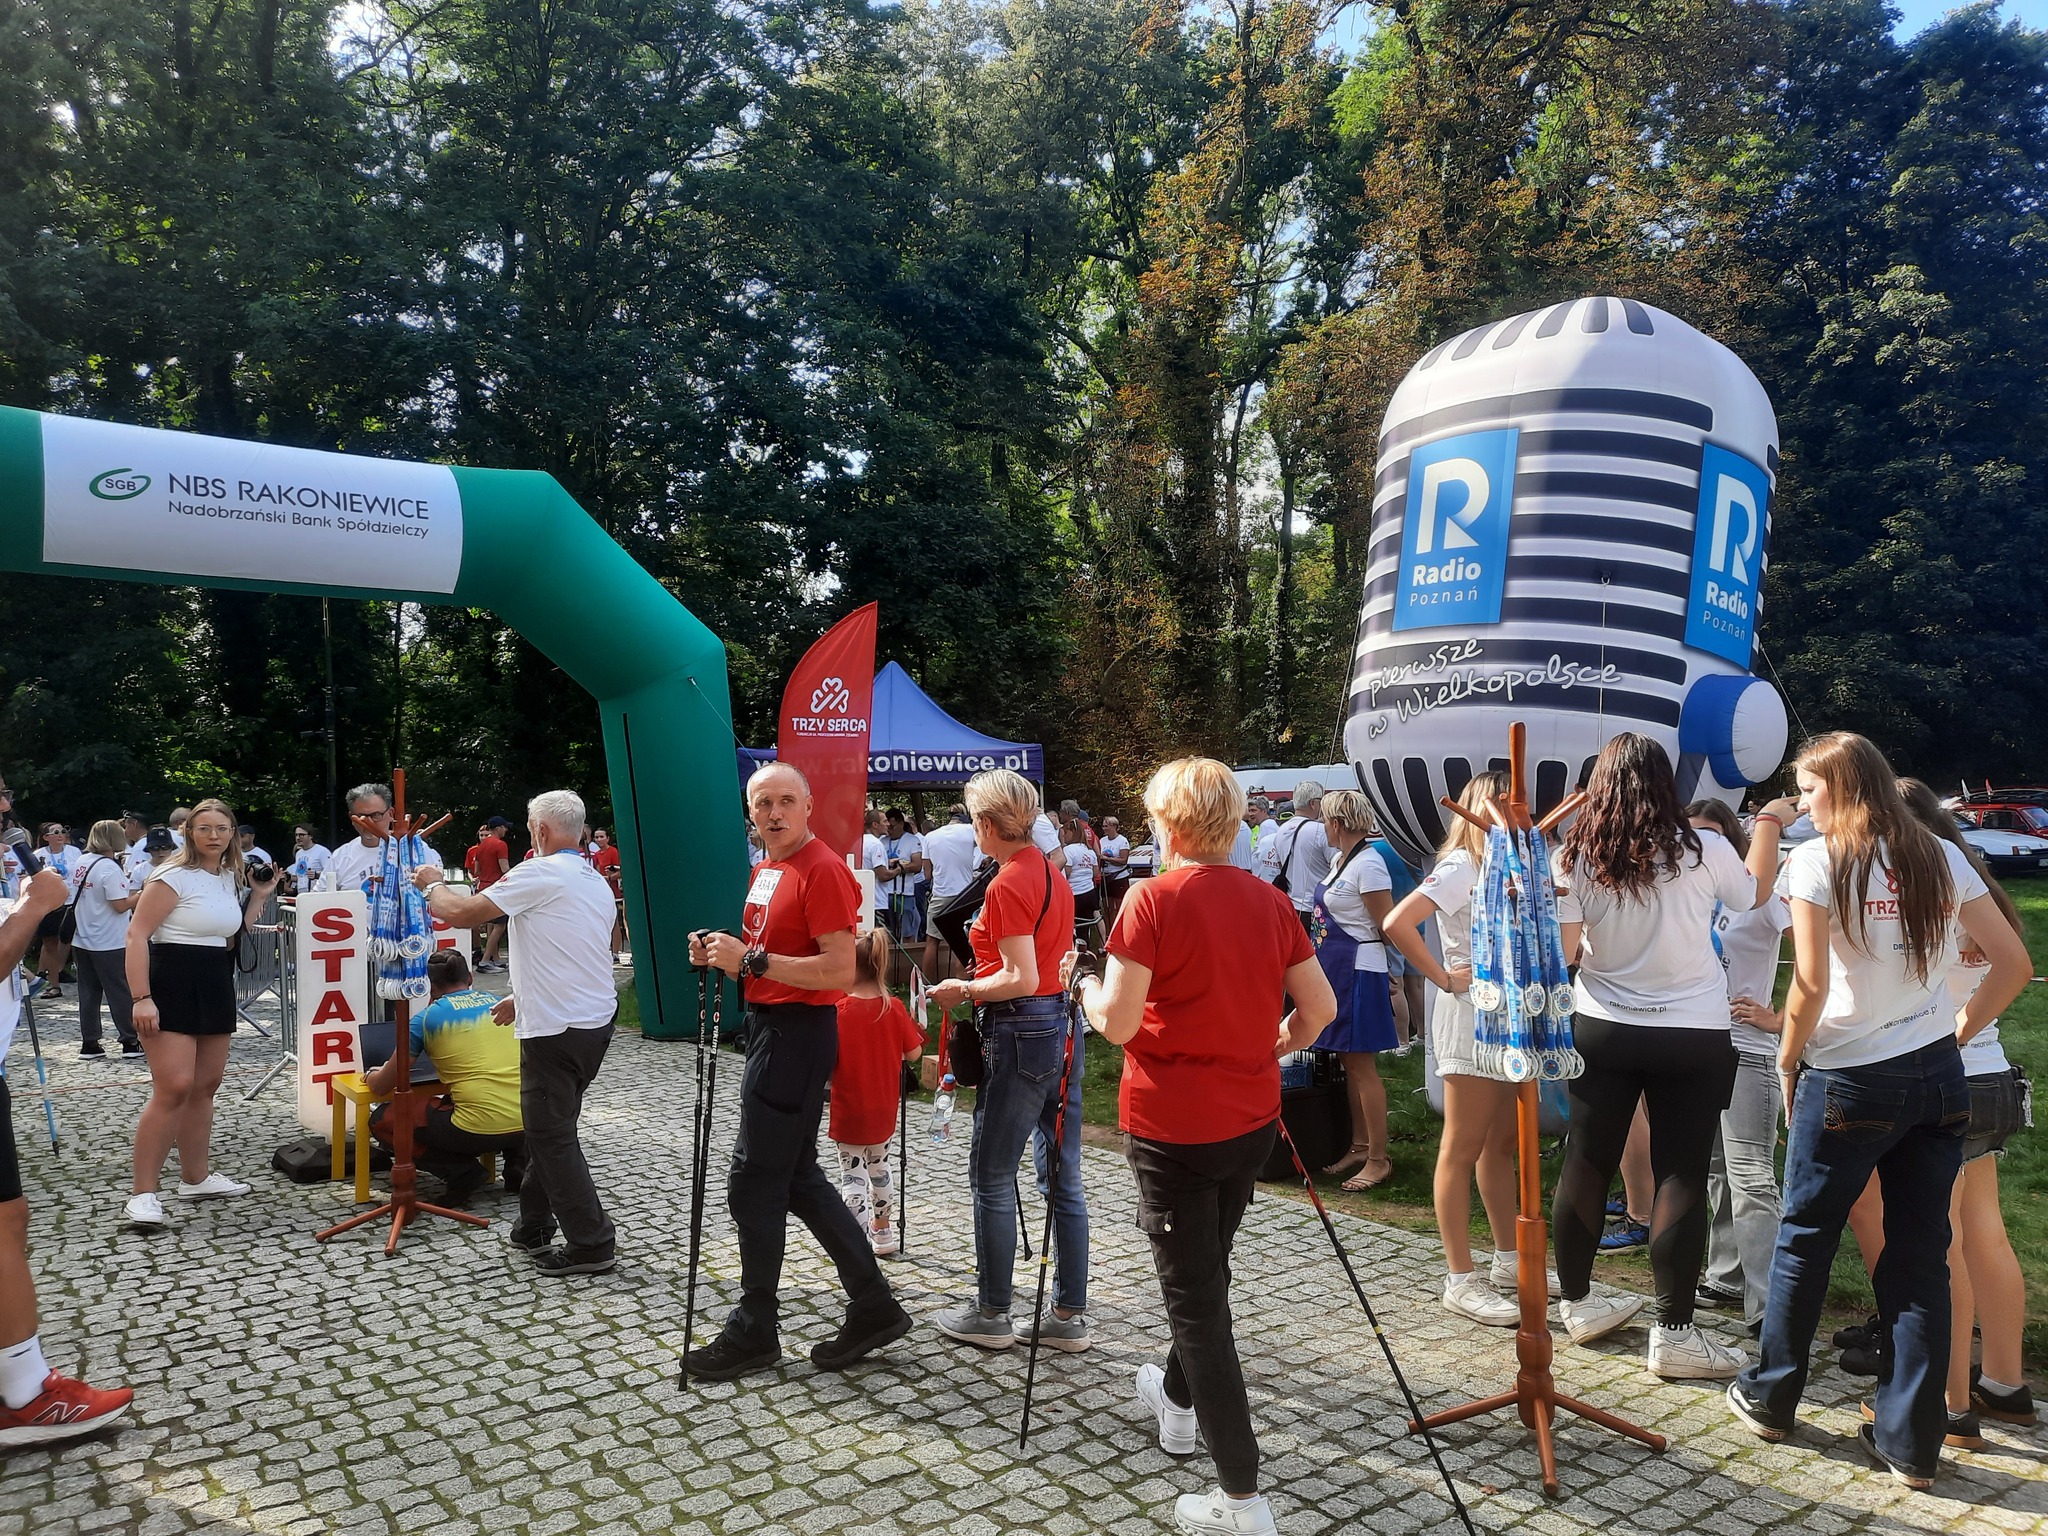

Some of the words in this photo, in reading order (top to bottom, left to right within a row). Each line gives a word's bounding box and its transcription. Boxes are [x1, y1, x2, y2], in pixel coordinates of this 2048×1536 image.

[104, 478, 137, 491] SGB
[169, 472, 227, 499] NBS
[238, 480, 429, 520] RAKONIEWICE
[168, 500, 286, 524] Nadobrzański
[292, 512, 332, 528] Bank
[336, 517, 429, 539] Spółdzielczy
[1412, 556, 1482, 587] Radio
[1409, 585, 1478, 607] Poznań
[1705, 580, 1749, 621] Radio
[1702, 610, 1746, 641] Poznań
[1369, 638, 1484, 707] pierwsze
[1368, 715, 1388, 740] w
[1396, 653, 1622, 723] Wielkopolsce
[791, 717, 825, 731] TRZY
[827, 718, 867, 732] SERCA
[1865, 900, 1898, 915] TRZ
[311, 908, 356, 1105] START
[1609, 1000, 1667, 1013] rakoniewice.pl
